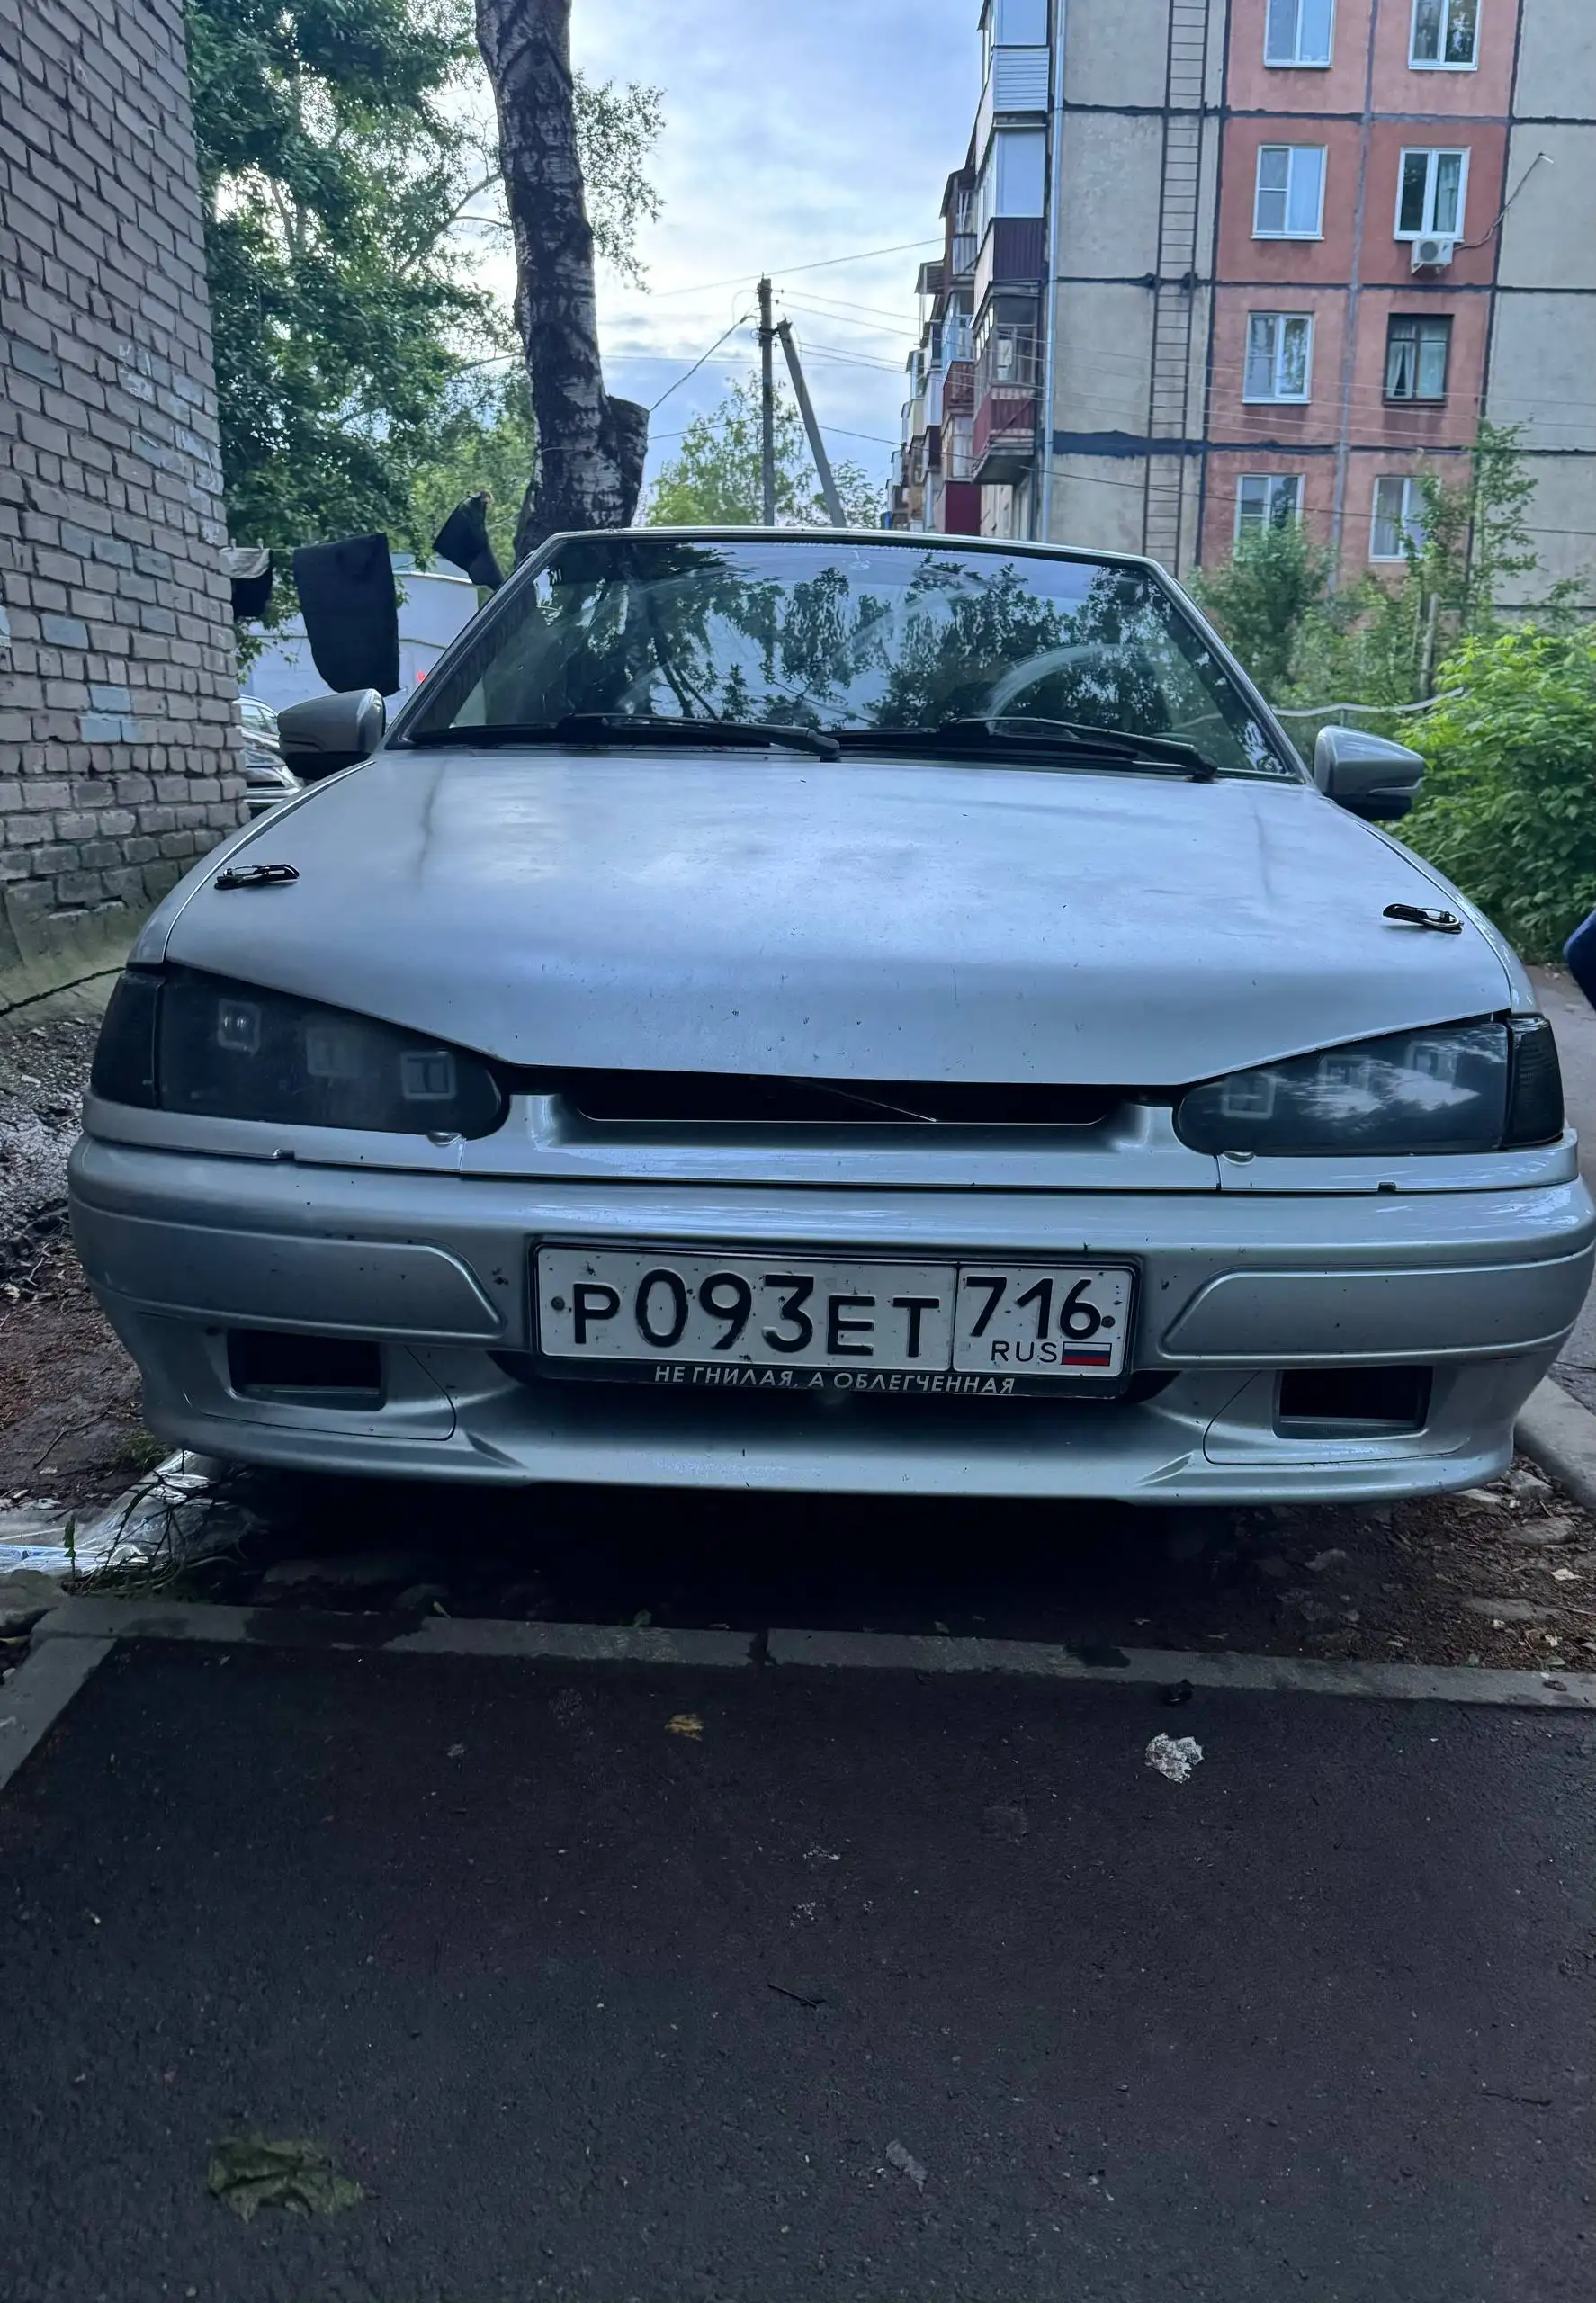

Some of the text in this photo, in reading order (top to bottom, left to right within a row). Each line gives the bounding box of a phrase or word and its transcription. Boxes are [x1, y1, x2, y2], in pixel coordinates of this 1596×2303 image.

[965, 1275, 1102, 1340] 716
[991, 1340, 1058, 1365] RUS
[654, 1365, 685, 1383] НЕ
[808, 1372, 825, 1387] А
[833, 1372, 1016, 1394] ОБЛЕГЧЕННАЯ
